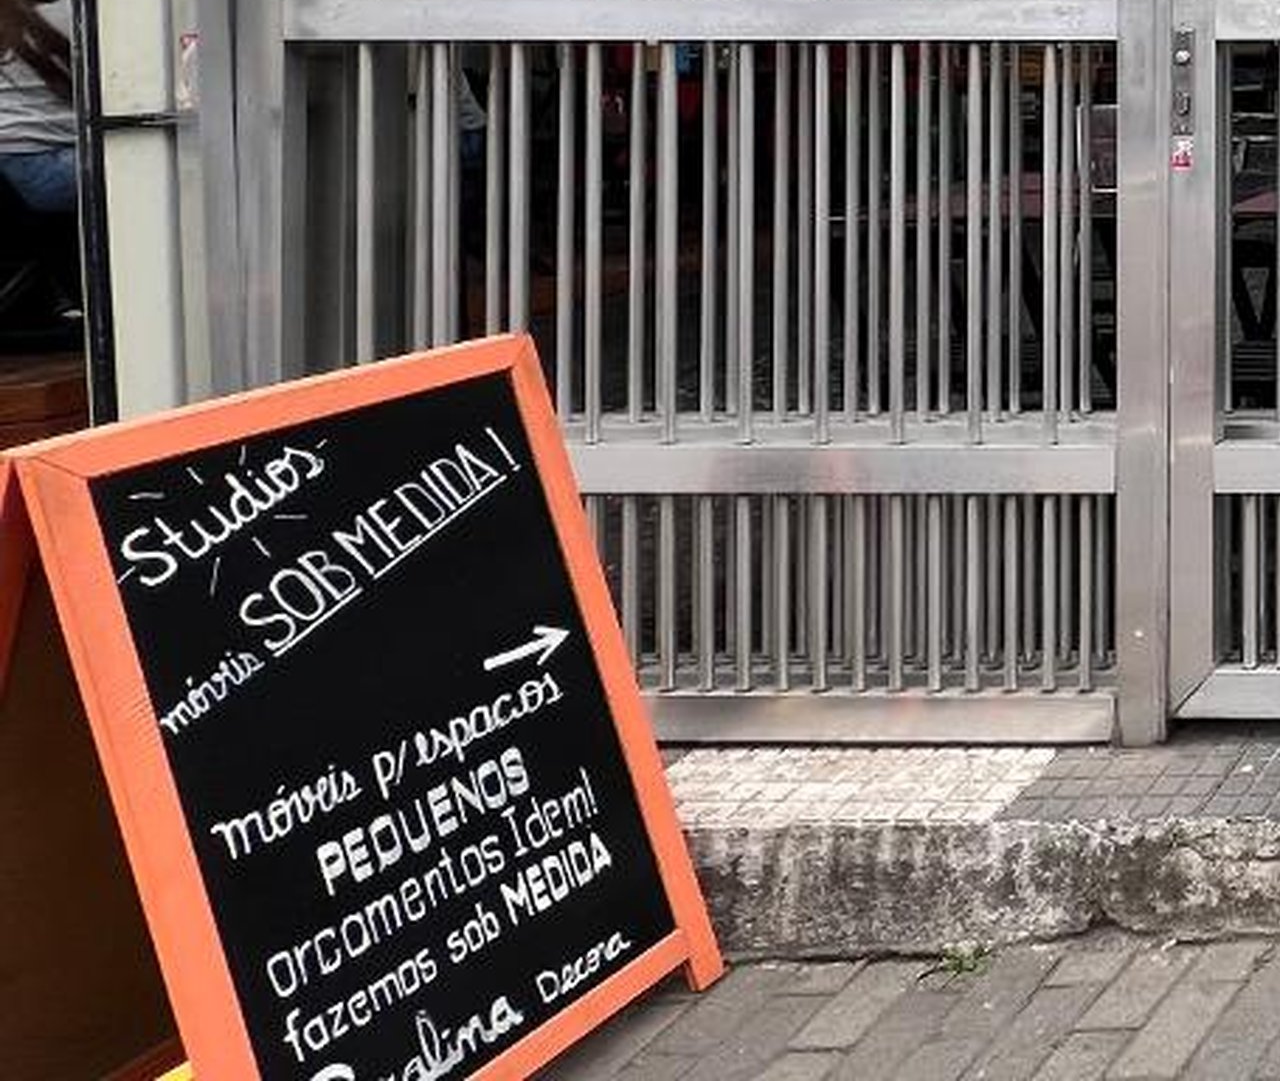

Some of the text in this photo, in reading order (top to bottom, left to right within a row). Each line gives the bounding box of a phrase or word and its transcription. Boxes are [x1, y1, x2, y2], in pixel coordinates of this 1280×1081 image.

[121, 446, 326, 587] Studios
[239, 550, 357, 651] SOB
[210, 765, 363, 860] móveis
[283, 831, 613, 1063] fazemos sob MEDIDA
